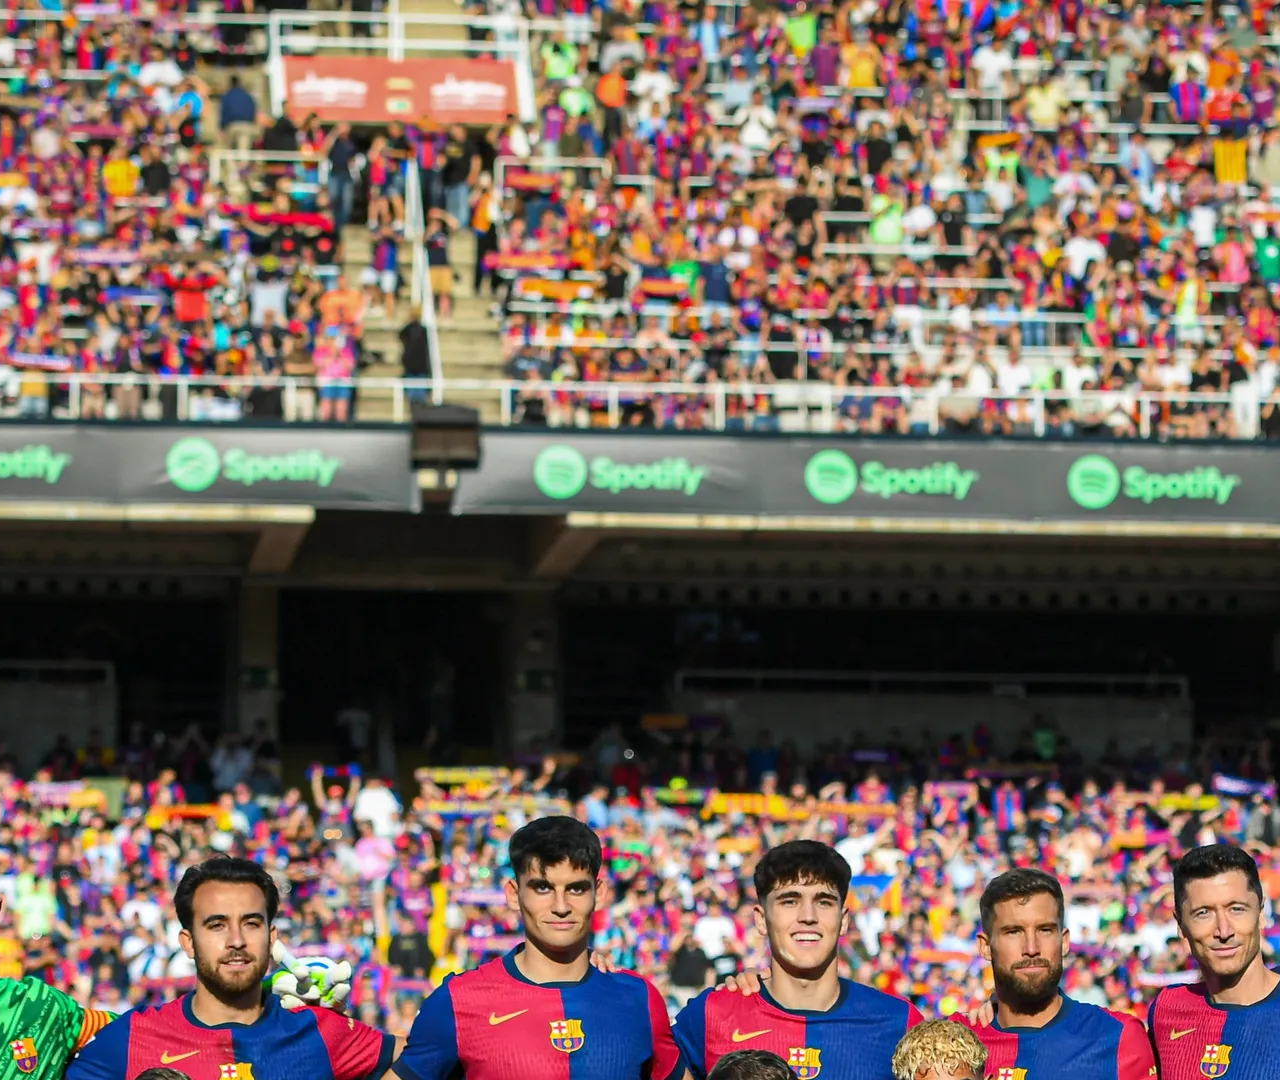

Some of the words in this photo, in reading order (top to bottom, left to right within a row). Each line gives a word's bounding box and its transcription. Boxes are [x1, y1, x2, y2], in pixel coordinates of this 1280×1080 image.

[222, 445, 341, 487] Spotify
[590, 455, 706, 495] Spotify
[860, 459, 977, 500] Spotify
[1122, 464, 1238, 505] Spotify
